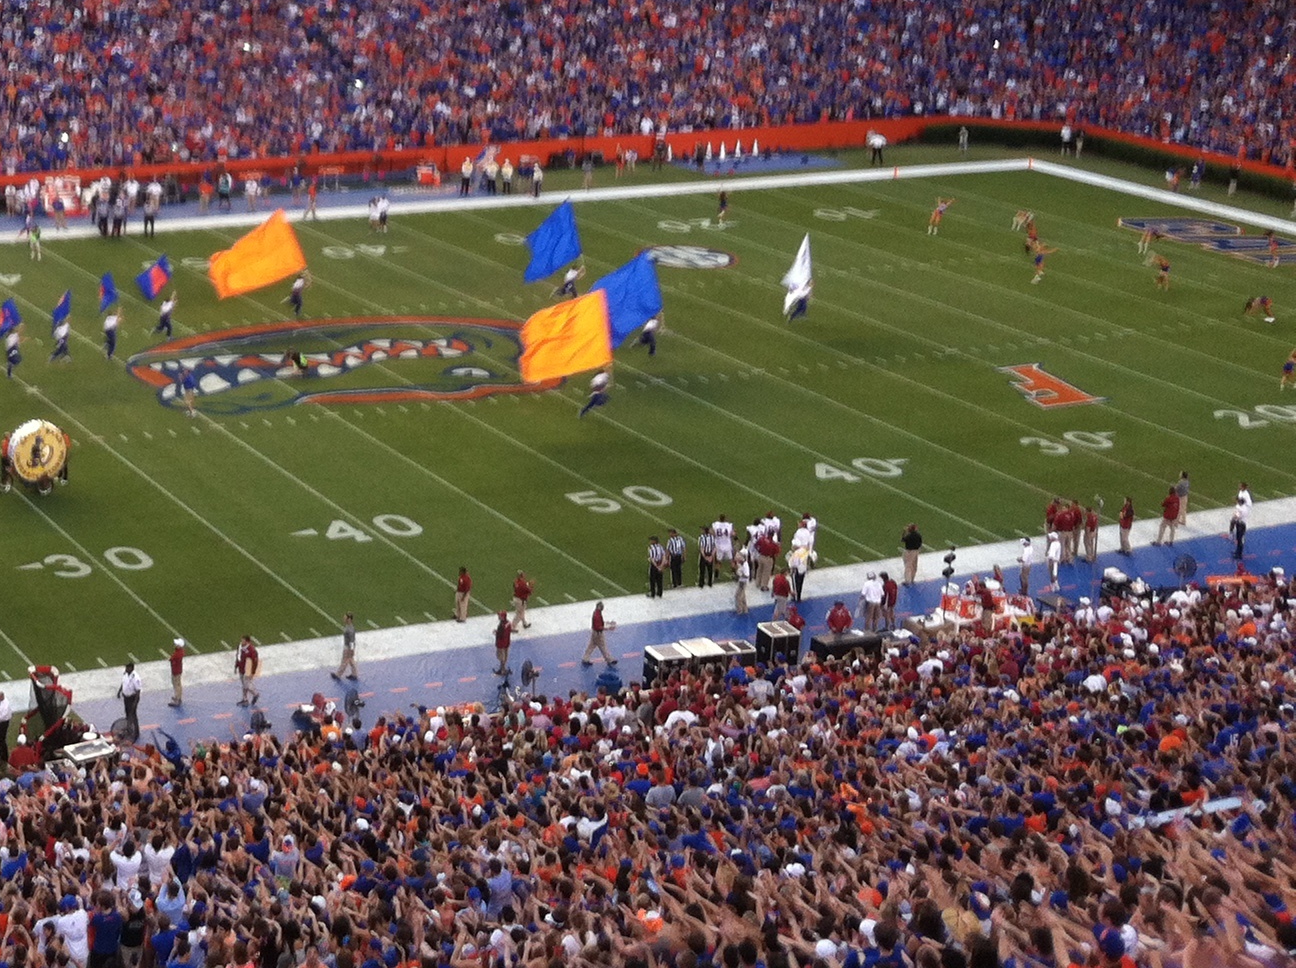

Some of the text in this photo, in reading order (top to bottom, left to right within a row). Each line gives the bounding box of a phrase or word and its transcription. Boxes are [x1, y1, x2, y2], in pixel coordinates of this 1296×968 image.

[1019, 431, 1114, 456] 30
[814, 457, 904, 482] 40
[564, 485, 674, 514] 50
[325, 514, 424, 543] 40
[43, 546, 154, 578] 30
